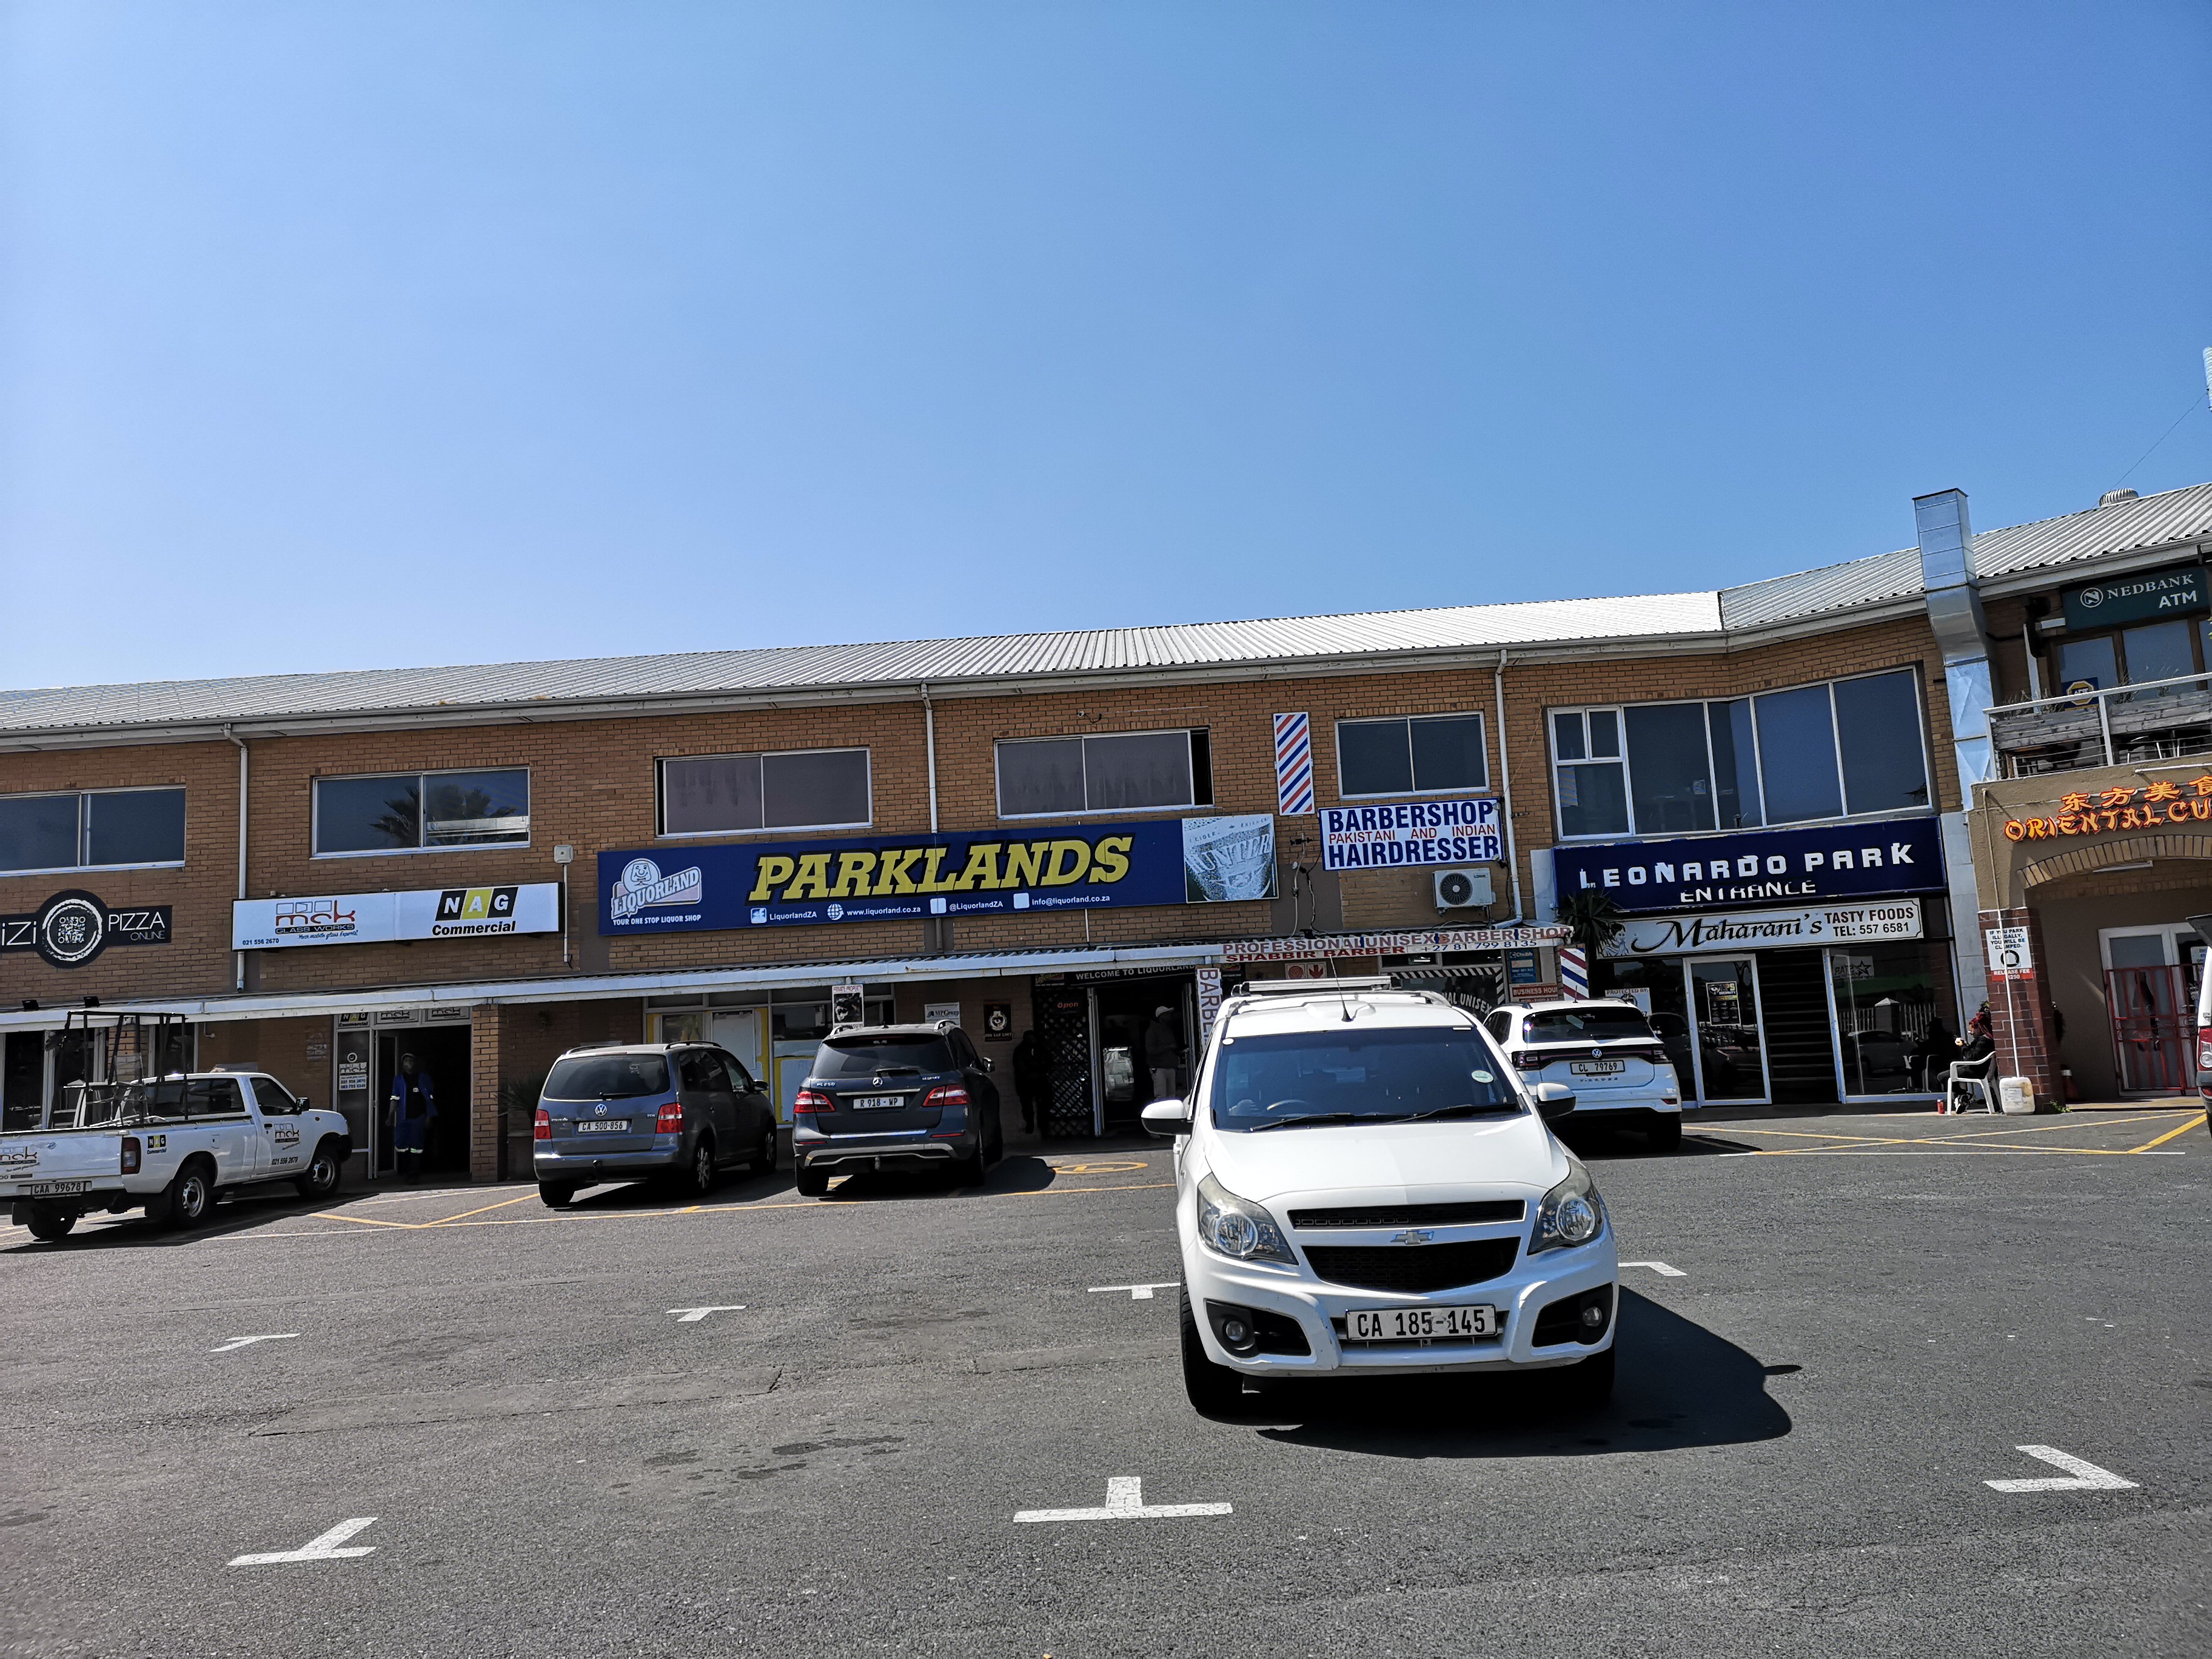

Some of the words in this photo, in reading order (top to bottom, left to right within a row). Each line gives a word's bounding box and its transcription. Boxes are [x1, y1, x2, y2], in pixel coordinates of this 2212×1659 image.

[2106, 574, 2194, 599] NEDBANK
[2159, 590, 2197, 608] ATM
[1328, 801, 1493, 833] BARBERSHOP
[2004, 803, 2165, 842] ORIENTAL
[1411, 827, 1438, 840] AND
[1452, 823, 1496, 837] INDIAN
[1328, 835, 1499, 868] HAIRDRESSER
[748, 837, 1133, 901] PARKLANDS
[1580, 855, 1787, 889] LEONARDO
[1804, 842, 1914, 872] PARK
[614, 871, 699, 916] LIQUORLAND
[1031, 895, 1110, 906] info@liquorland.co.za
[444, 894, 509, 914] NAG
[847, 907, 921, 917] www.liquorland.co.za
[949, 900, 1004, 911] @LiquorlandZA
[109, 911, 166, 932] PIZZA
[1825, 910, 1865, 924] TASTY
[1869, 907, 1914, 921] FOODS
[130, 930, 166, 940] ONLINE
[432, 920, 515, 936] Commercial
[1631, 913, 1823, 953] Maharani's
[1833, 926, 1856, 937] TEL:
[1860, 924, 1879, 934] 557
[1883, 922, 1909, 933] 6581
[1223, 937, 1361, 954] PROFESSIONAL
[1366, 934, 1435, 947] UNISEX
[1439, 930, 1513, 944] BARBER
[1520, 927, 1570, 939] SHOP
[1226, 950, 1316, 962] SHABBIR
[1324, 947, 1405, 957] BARBER
[1076, 970, 1121, 980] WELCOME
[1460, 993, 1492, 1014] UNISEX
[1578, 1064, 1588, 1072] CL
[1595, 1062, 1617, 1071] 79769
[867, 1099, 880, 1107] 918
[889, 1098, 898, 1106] WP
[582, 1122, 591, 1131] CA
[34, 1185, 50, 1194] CAA
[55, 1182, 81, 1193] 99678
[1358, 1313, 1382, 1337] CA
[1395, 1309, 1486, 1336] 185-145
